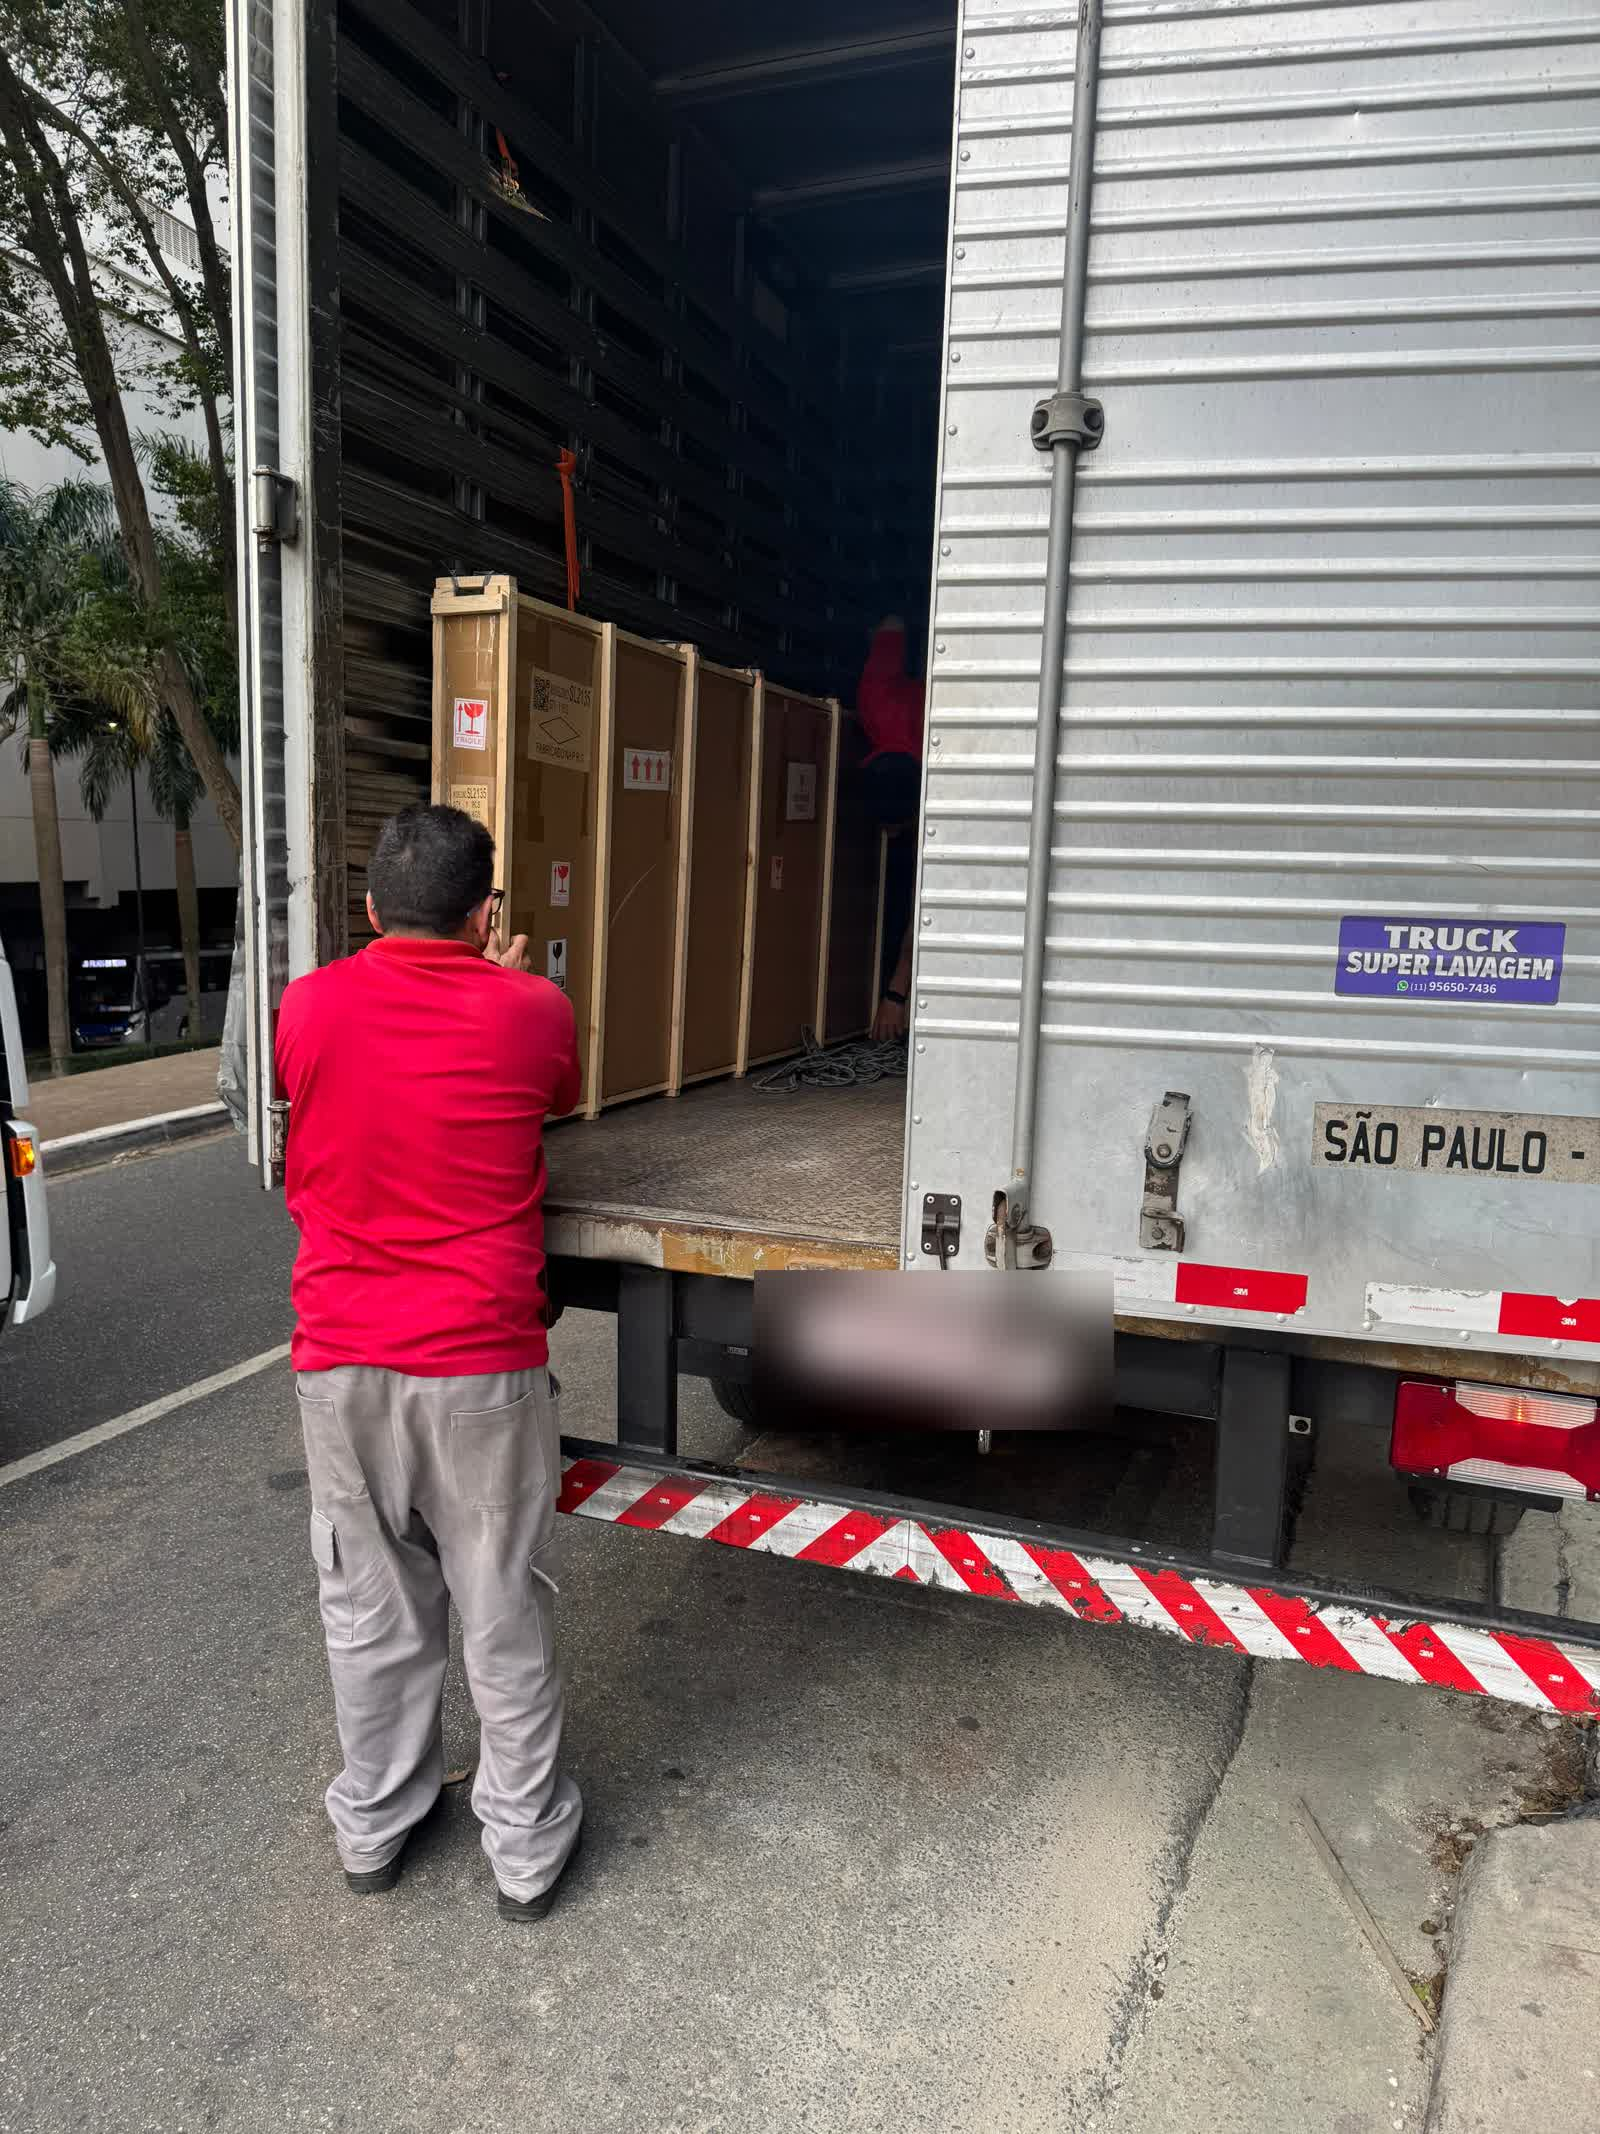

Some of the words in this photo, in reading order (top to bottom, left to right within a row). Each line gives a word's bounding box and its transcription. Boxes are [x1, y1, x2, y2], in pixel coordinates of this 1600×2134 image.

[1384, 926, 1520, 953] TRUCK
[1345, 951, 1430, 976] SUPER
[1434, 954, 1555, 981] LAVAGEM
[1410, 983, 1427, 992] (11)
[1429, 982, 1497, 994] 95650-7436
[1324, 1111, 1399, 1165] SÃO
[1421, 1124, 1548, 1174] PAULO
[1233, 1287, 1249, 1296] 3M
[1561, 1317, 1577, 1326] 3M
[659, 1497, 670, 1505] 3M
[749, 1514, 761, 1522] 3M
[844, 1533, 856, 1541] 3M
[963, 1558, 975, 1567] 3M
[1068, 1580, 1082, 1589] 3M
[1179, 1603, 1193, 1612] 3M
[1296, 1626, 1311, 1635] 3M
[1419, 1649, 1434, 1658] 3M
[1548, 1674, 1564, 1683] 3M
